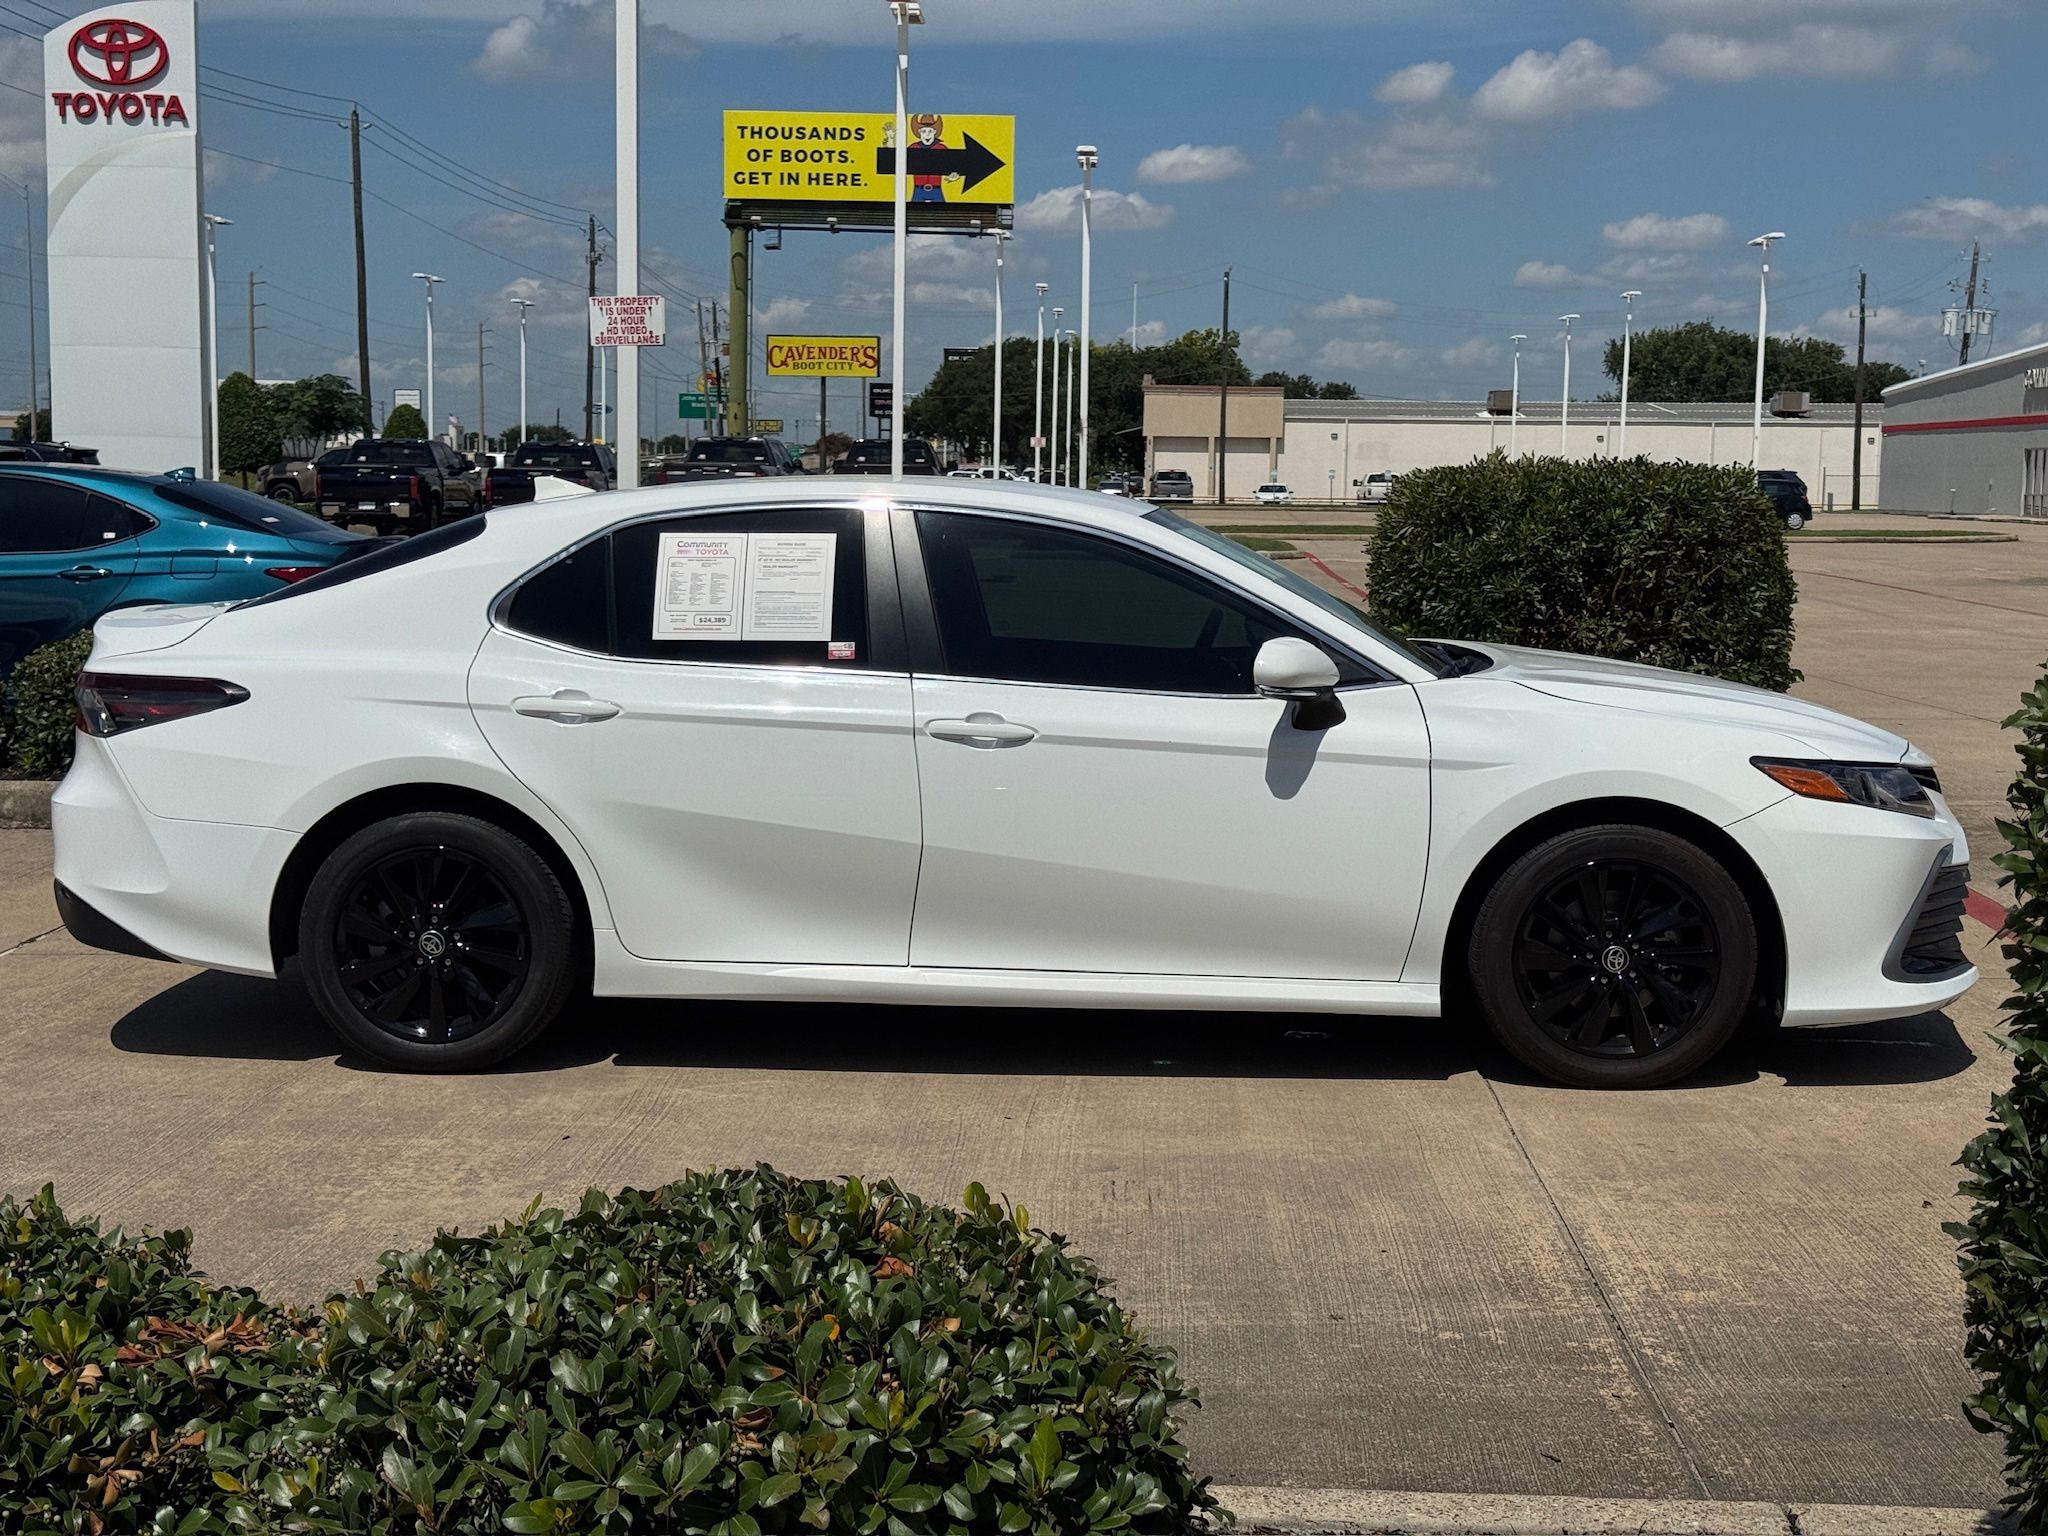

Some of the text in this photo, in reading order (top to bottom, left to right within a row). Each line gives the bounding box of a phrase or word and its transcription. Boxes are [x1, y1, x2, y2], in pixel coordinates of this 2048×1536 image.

[51, 92, 188, 121] TOYOTA
[736, 125, 866, 141] THOUSANDS
[746, 148, 856, 164] OF BOOTS.
[733, 171, 869, 187] GET IN HERE.
[591, 296, 660, 306] THIS PROPERTY
[605, 306, 647, 316] IS UNDER
[607, 316, 646, 326] 24 HOUR
[606, 326, 648, 335] HD VIDEO
[595, 335, 661, 345] SURVEILLANCE
[768, 343, 878, 370] CAVENDER'S
[792, 361, 854, 371] BOOT CITY
[695, 548, 729, 556] TOYOTA
